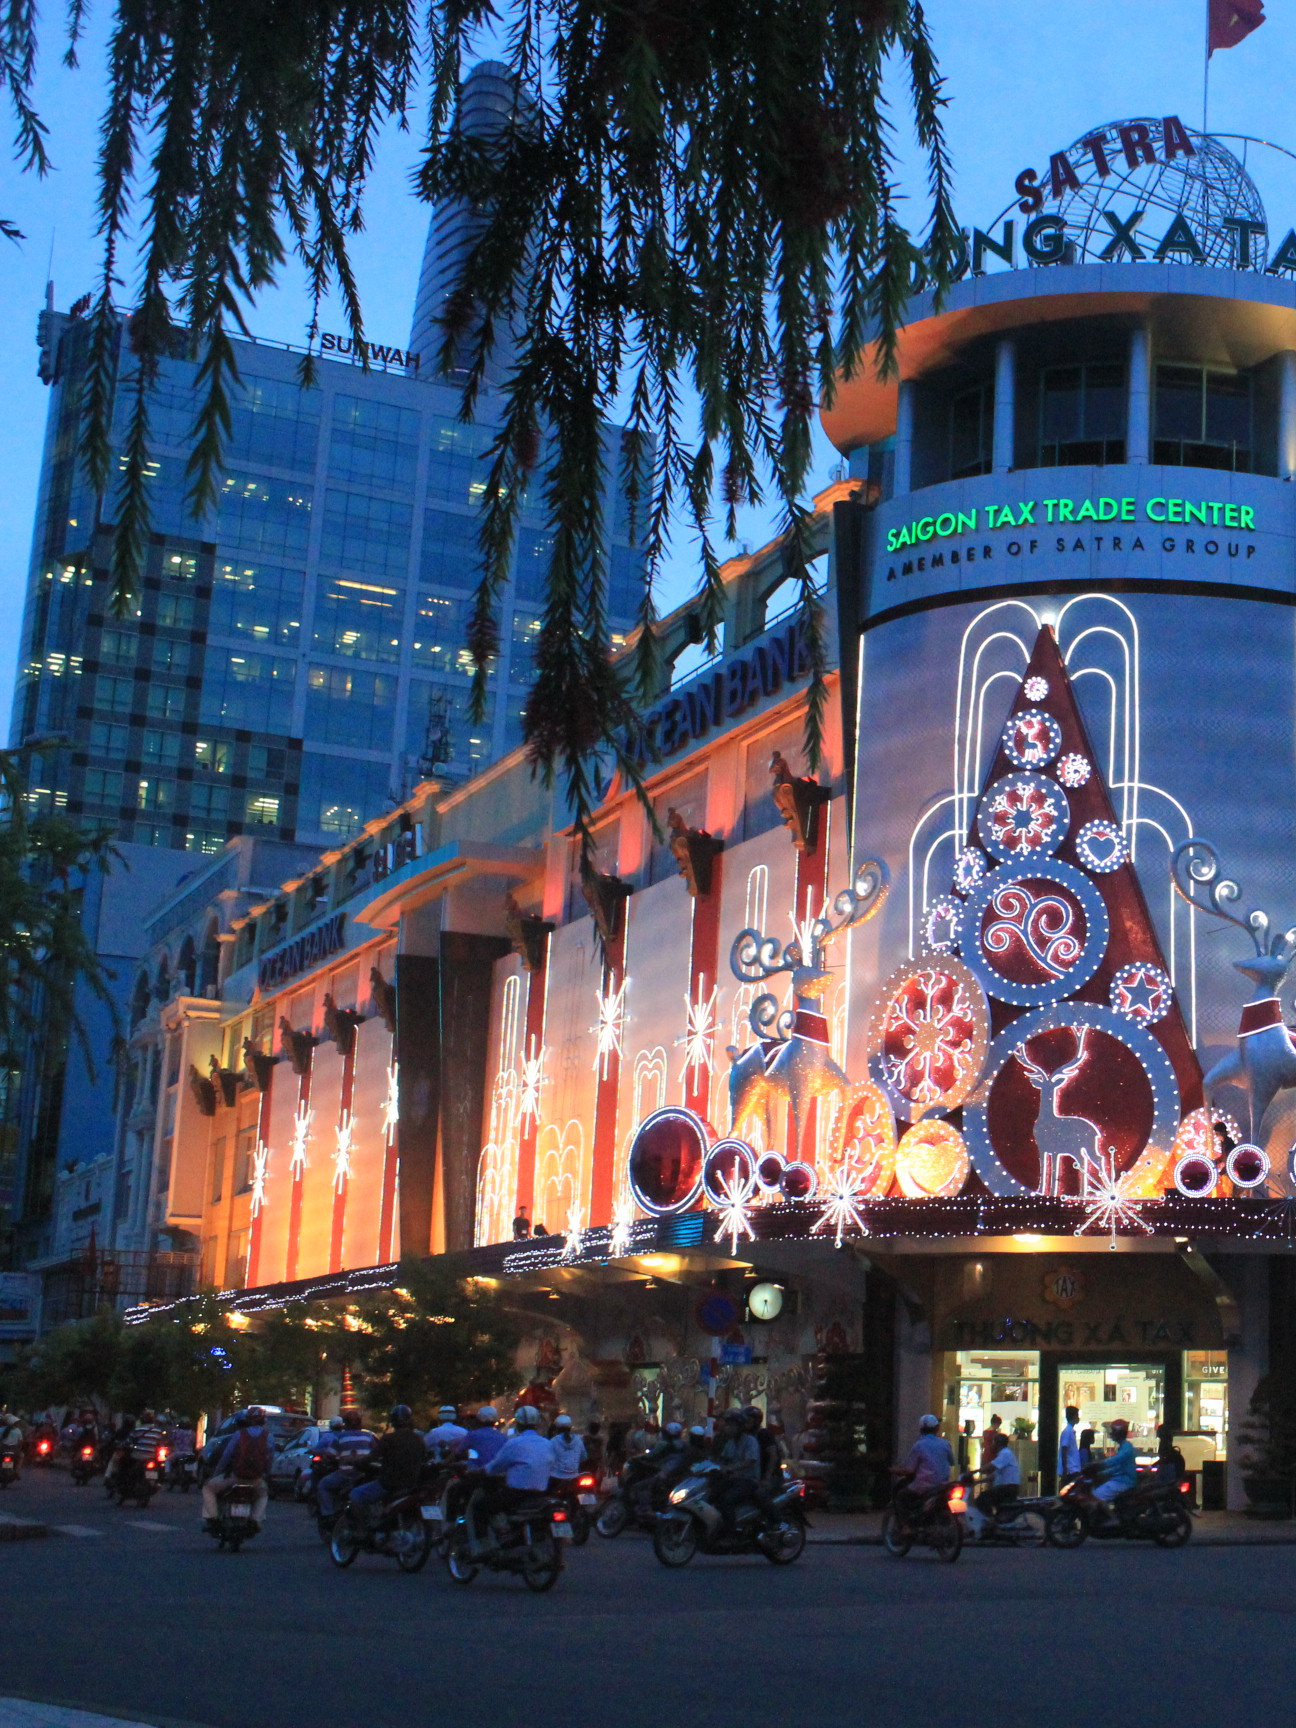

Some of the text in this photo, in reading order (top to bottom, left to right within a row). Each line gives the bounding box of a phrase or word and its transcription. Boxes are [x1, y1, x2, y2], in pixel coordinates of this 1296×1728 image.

[1014, 115, 1197, 215] SATRA
[886, 497, 1256, 552] SAIGON TAX TRADE CENTER
[902, 544, 993, 577] MEMBER
[1007, 540, 1039, 556] OF
[1056, 537, 1146, 553] SATRA
[1162, 537, 1256, 560] GROUP
[1056, 1276, 1079, 1298] TAX
[1135, 1319, 1196, 1345] TAX
